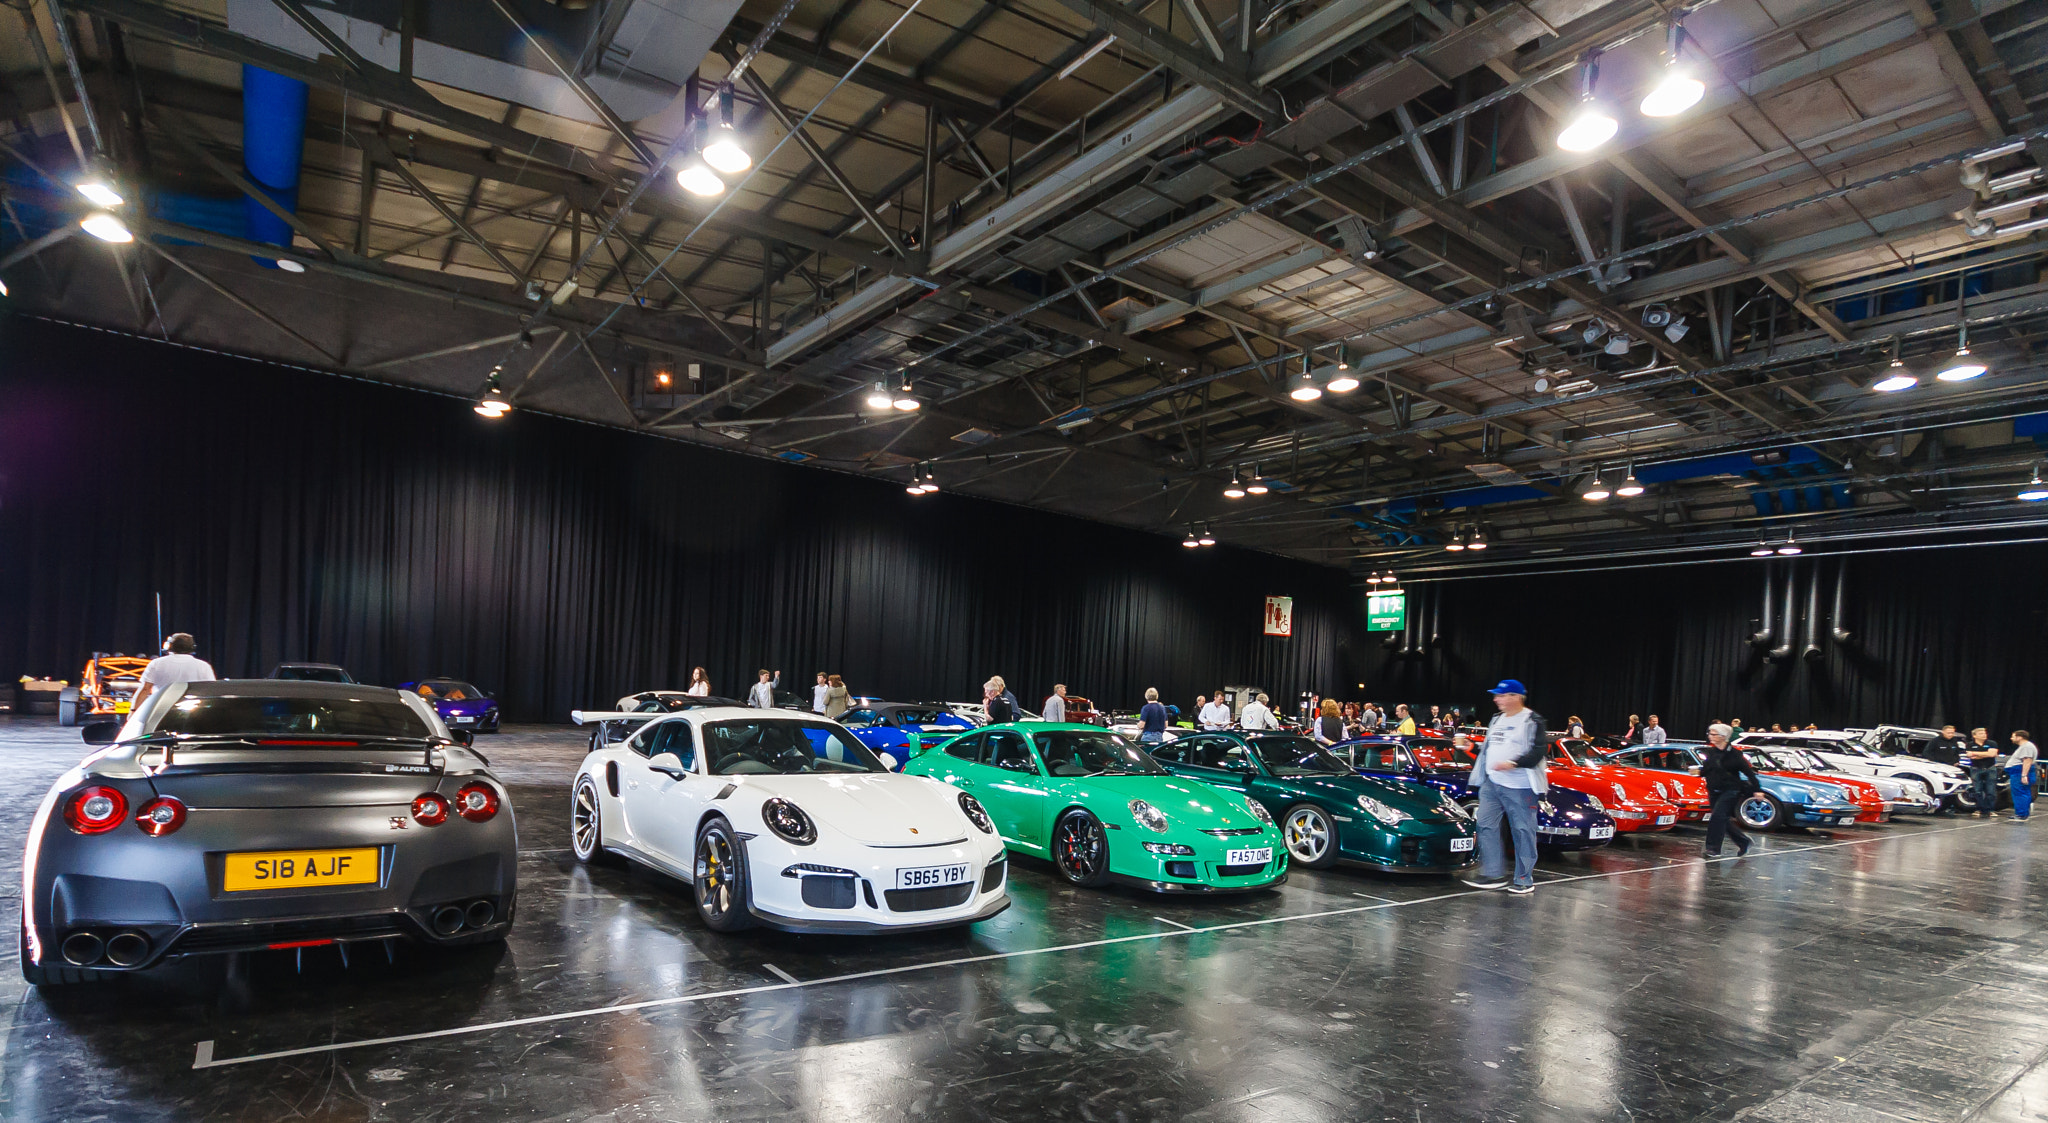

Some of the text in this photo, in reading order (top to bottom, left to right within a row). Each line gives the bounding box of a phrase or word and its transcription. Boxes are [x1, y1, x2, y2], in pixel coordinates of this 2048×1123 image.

[1452, 840, 1465, 850] ALS
[1231, 849, 1270, 863] FA57 ONE
[254, 856, 352, 880] S18 AJF
[904, 866, 966, 886] SB65 YBY
